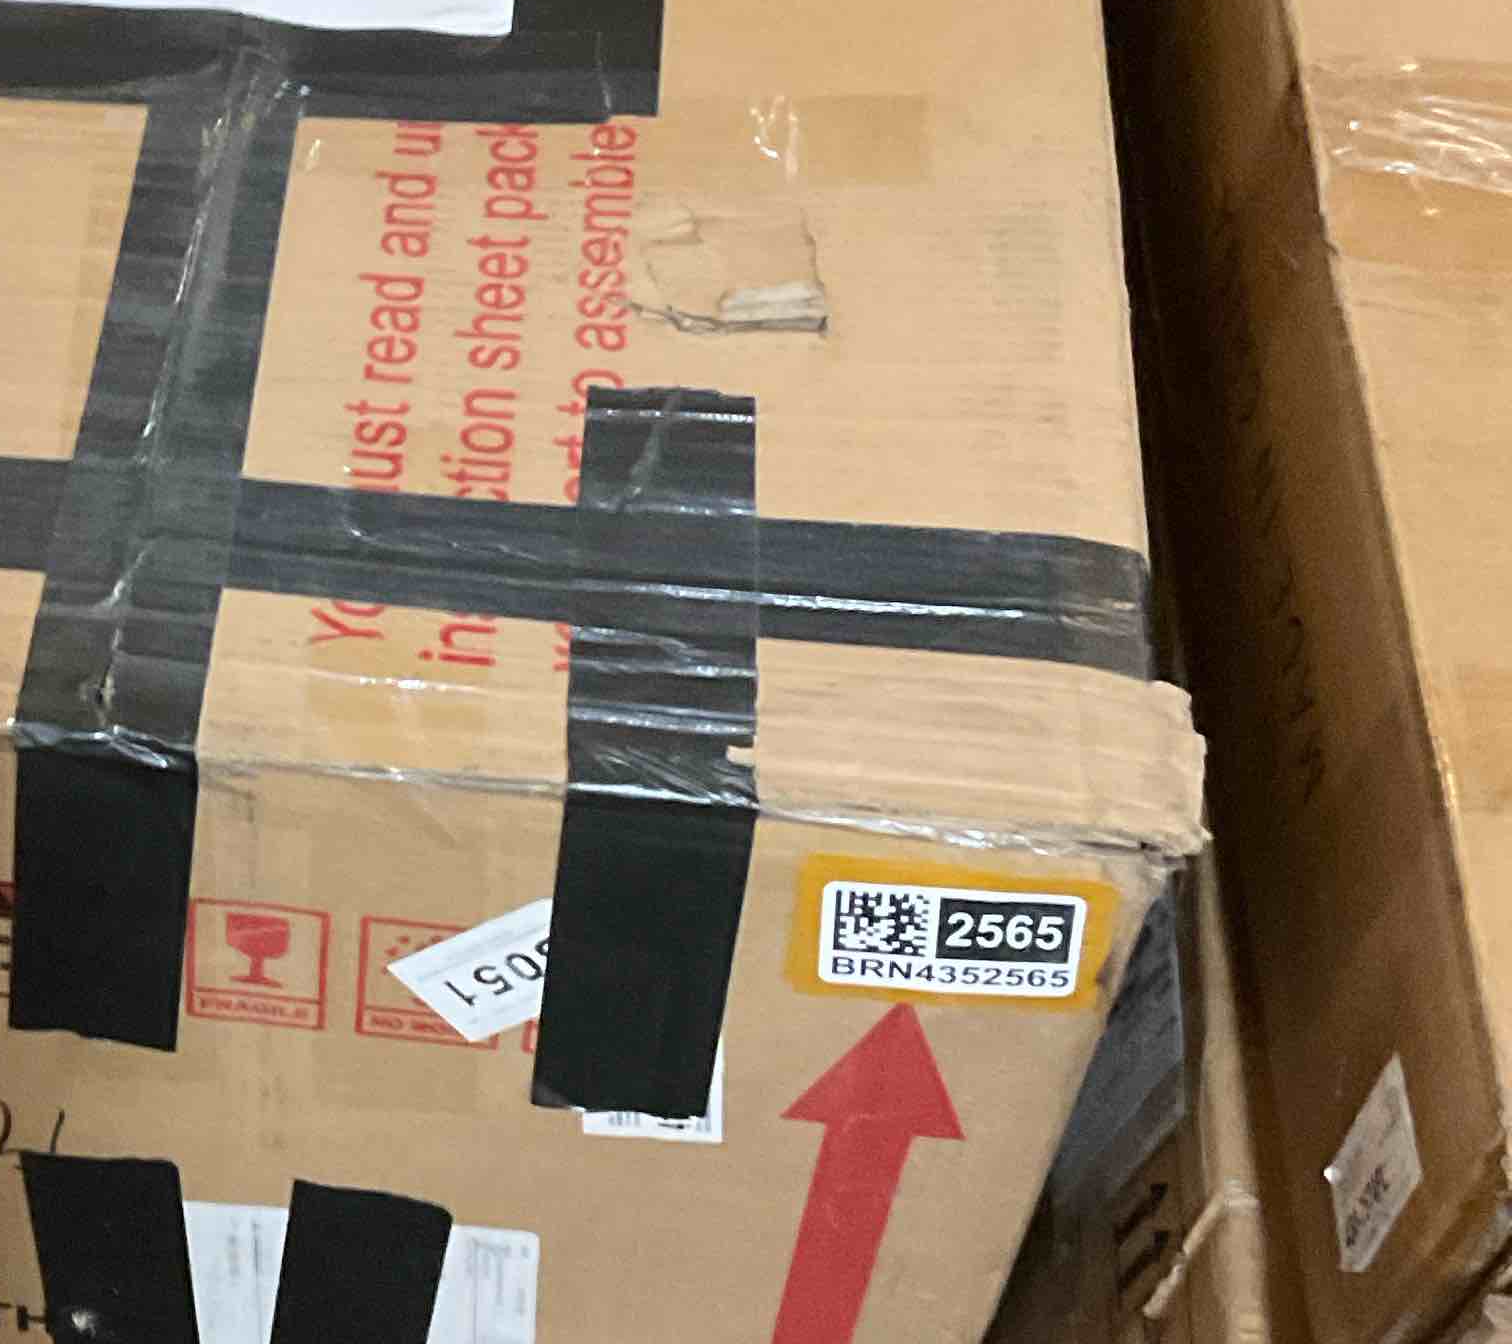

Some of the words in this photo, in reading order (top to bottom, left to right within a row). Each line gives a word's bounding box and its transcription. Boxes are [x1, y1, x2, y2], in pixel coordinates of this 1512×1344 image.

[374, 169, 439, 259] and
[357, 271, 426, 384] read
[453, 233, 532, 371] sheet
[831, 956, 1071, 989] BRN4352565
[944, 911, 1066, 952] 2565
